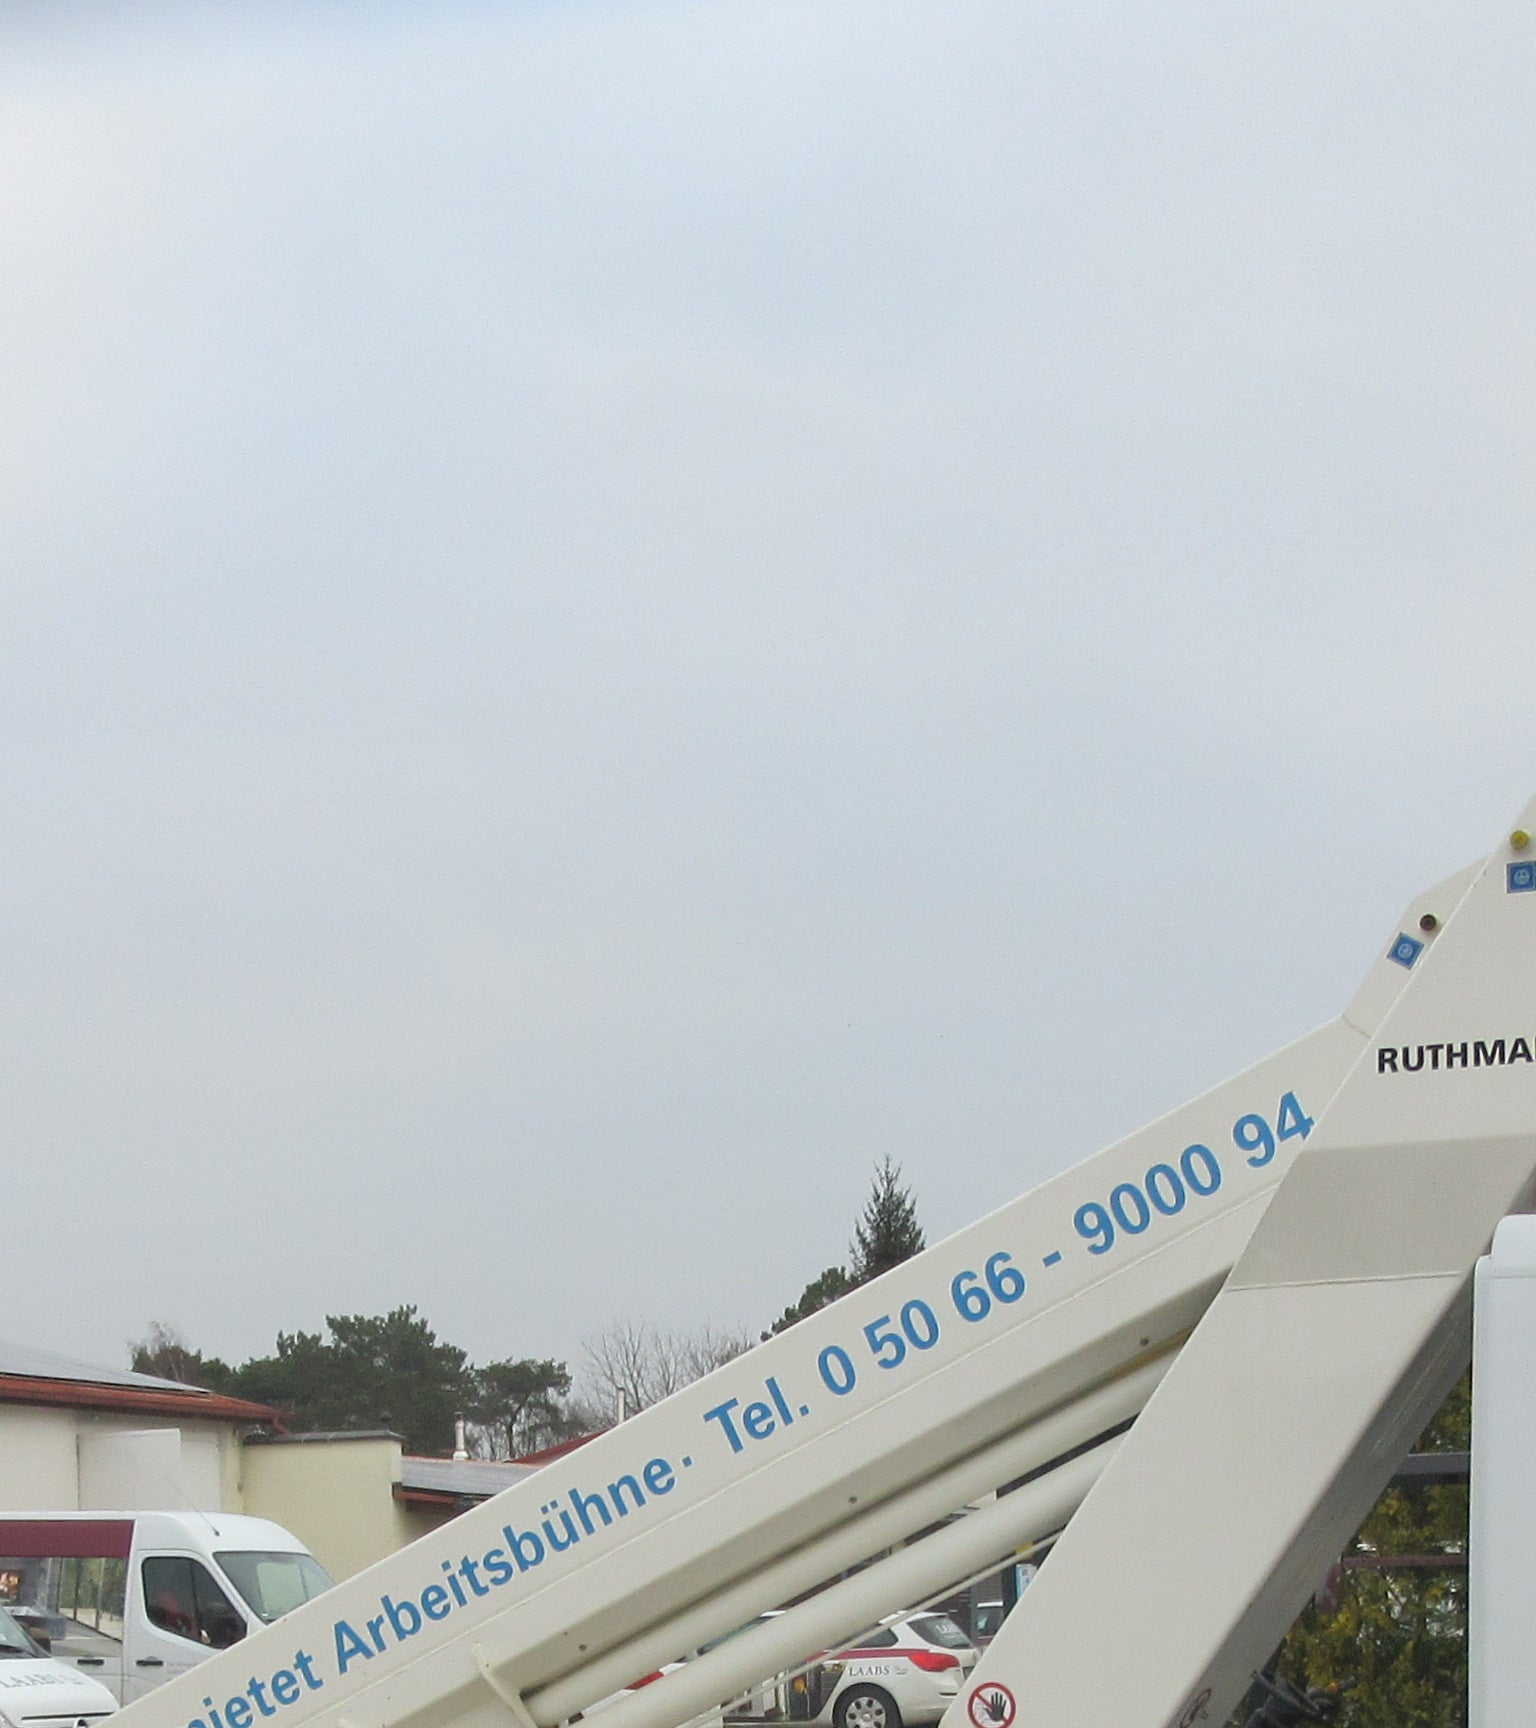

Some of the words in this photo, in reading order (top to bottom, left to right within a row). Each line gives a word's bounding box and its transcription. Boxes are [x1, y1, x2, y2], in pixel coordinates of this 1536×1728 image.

[703, 1378, 811, 1454] Tel.
[818, 1346, 856, 1395] 0
[864, 1316, 940, 1369] 50
[952, 1252, 1026, 1322] 66
[1075, 1144, 1222, 1254] 9000
[1234, 1092, 1315, 1168] 94
[848, 1665, 890, 1677] LAABS
